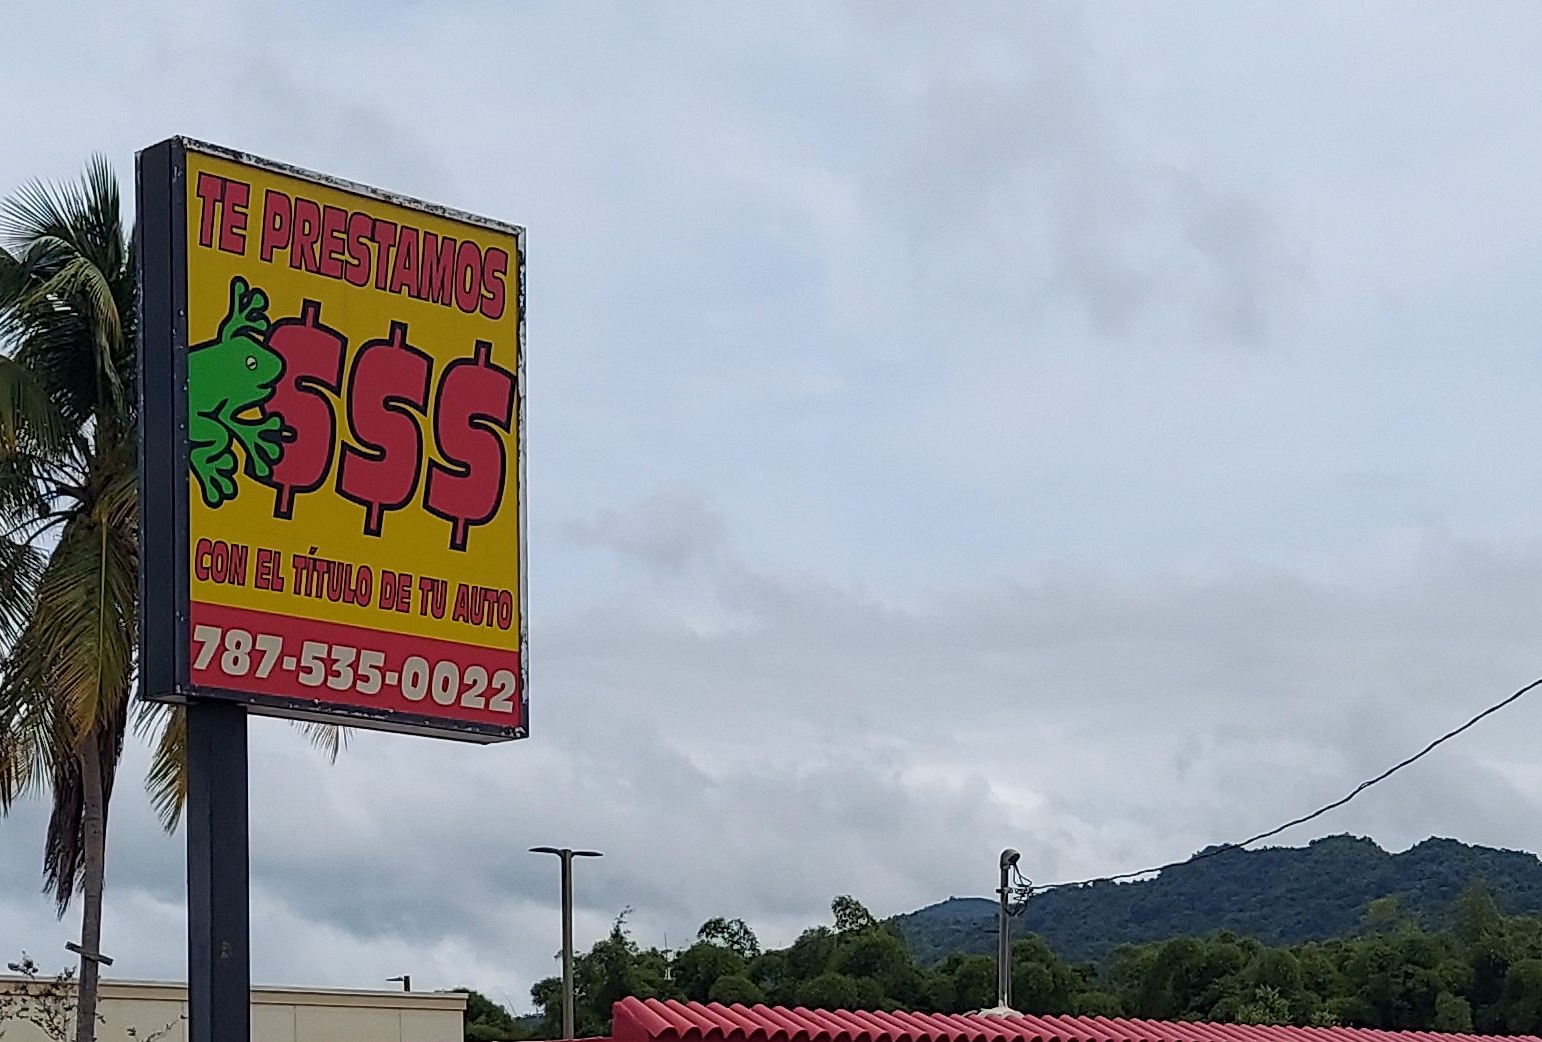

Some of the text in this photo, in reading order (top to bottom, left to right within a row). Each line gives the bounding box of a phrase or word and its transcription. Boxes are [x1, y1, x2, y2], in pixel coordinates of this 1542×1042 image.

[196, 171, 509, 320] TE PRESTAMOS
[244, 298, 515, 552] $$$
[194, 538, 513, 630] CON EL TÍTULO DE TU AUTO
[192, 624, 517, 713] 787-535-0022
